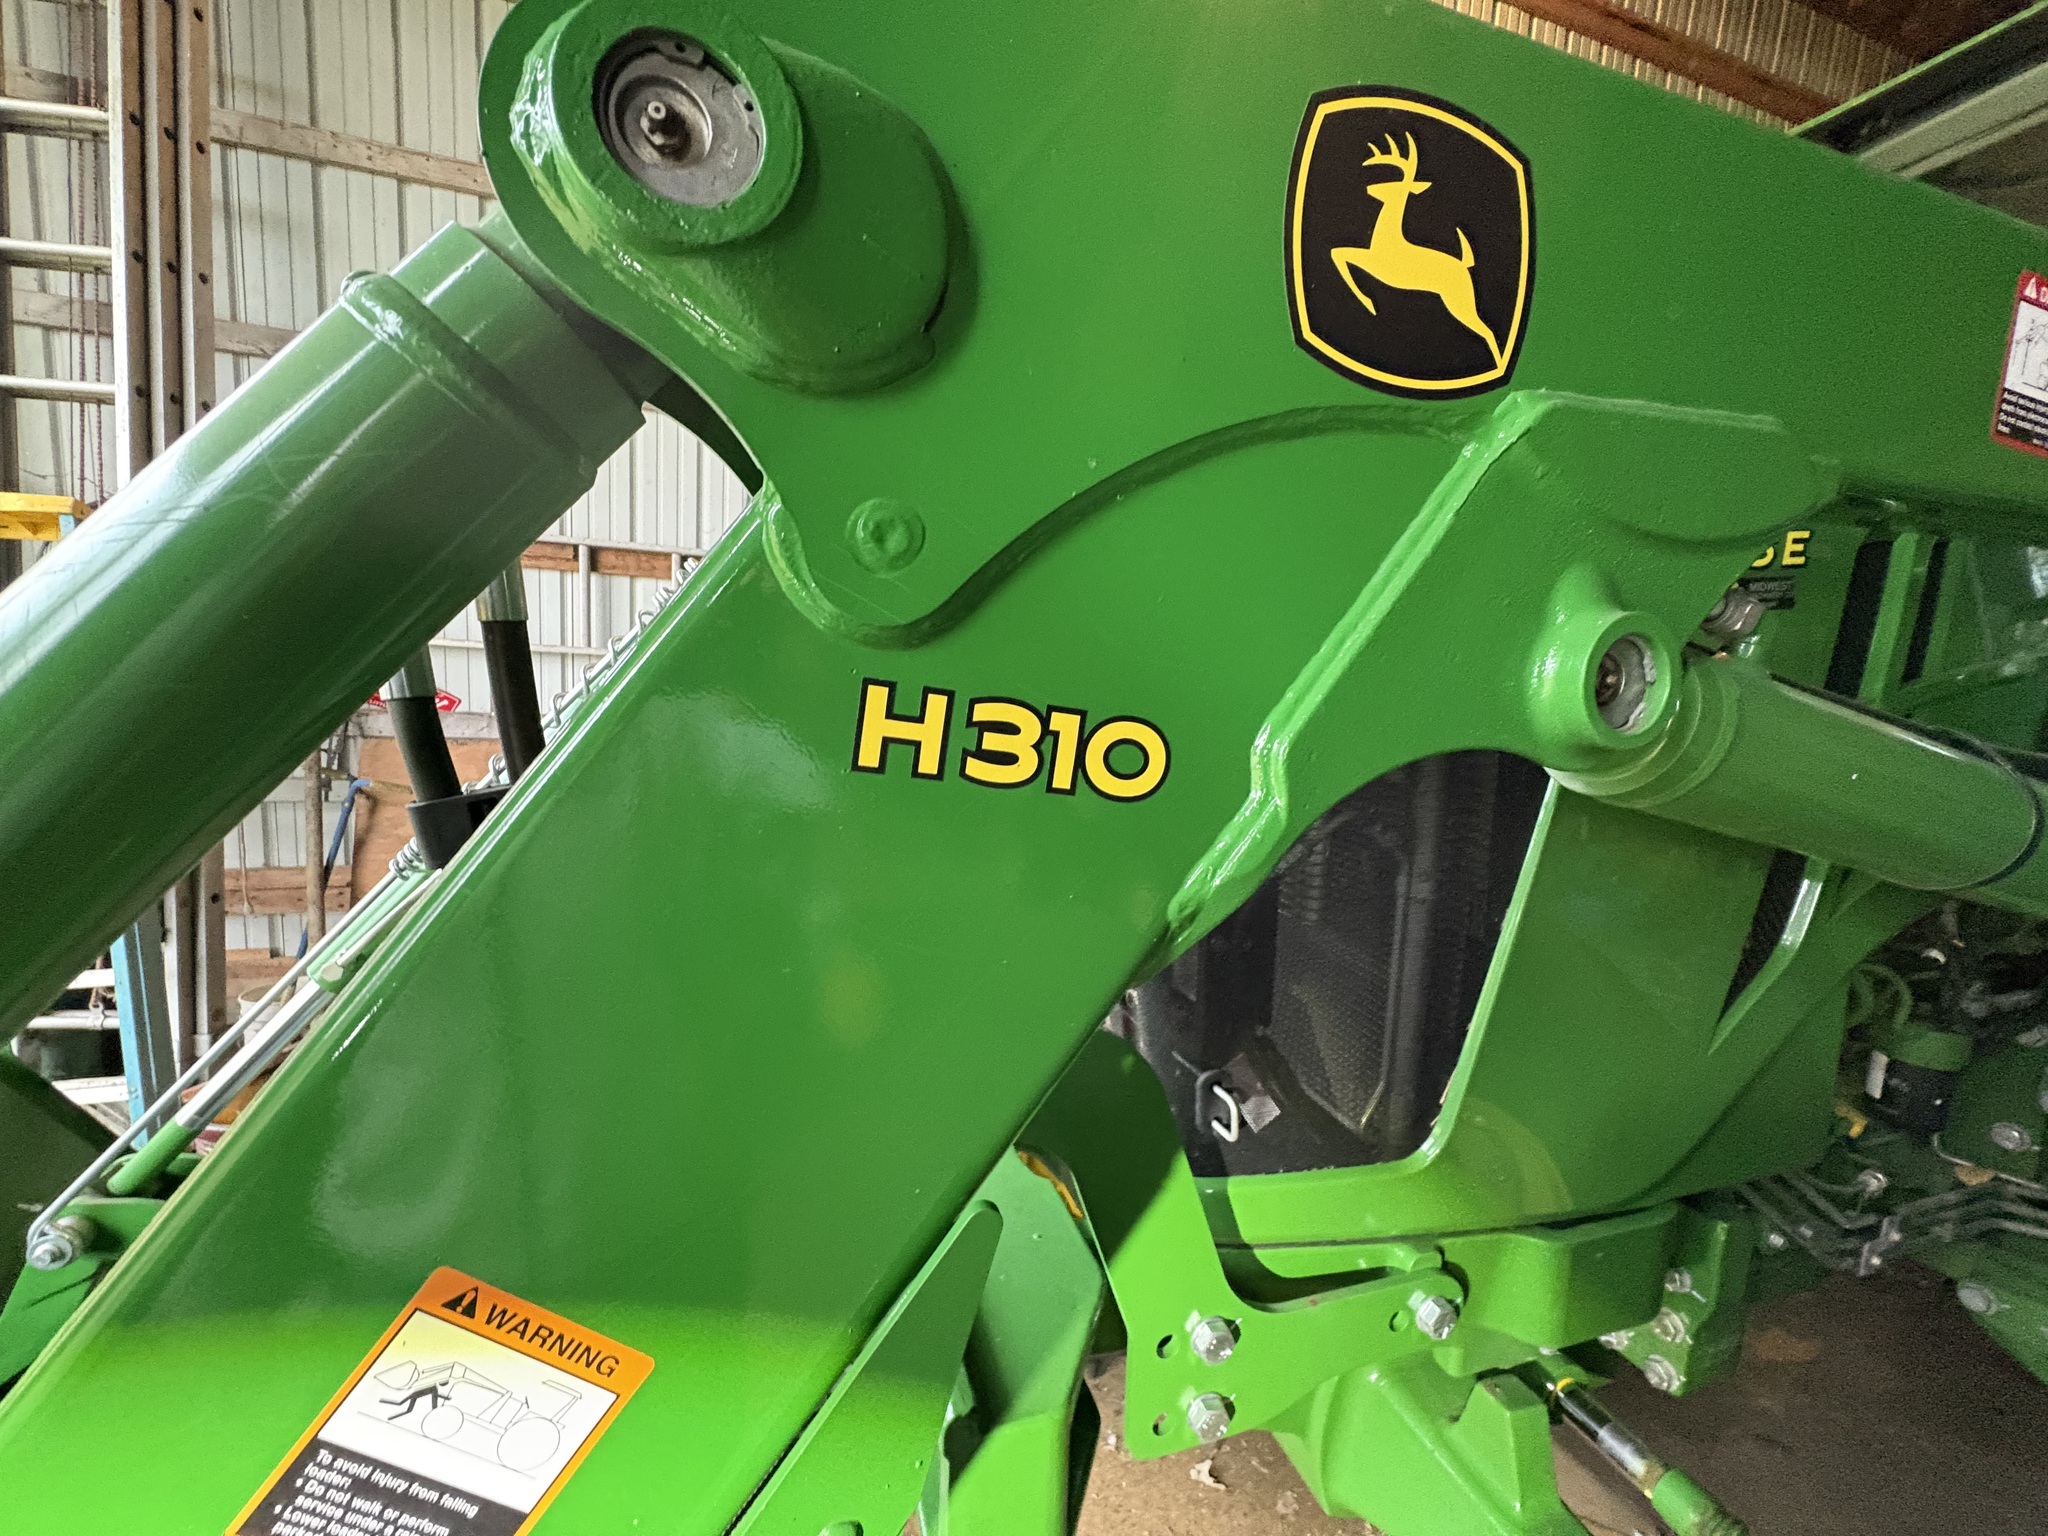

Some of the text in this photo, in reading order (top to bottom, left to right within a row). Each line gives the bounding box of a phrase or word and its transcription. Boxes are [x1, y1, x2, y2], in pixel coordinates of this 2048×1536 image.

[486, 1303, 620, 1378] WARNING
[304, 1462, 352, 1489] loader:
[316, 1449, 479, 1520] To avoid injury from falling
[282, 1504, 327, 1531] Lower
[294, 1495, 344, 1520] service
[344, 1511, 385, 1533] under
[304, 1479, 325, 1497] Do
[325, 1488, 352, 1506] not
[351, 1496, 383, 1516] walk
[383, 1508, 400, 1521] or
[397, 1513, 450, 1536] perform
